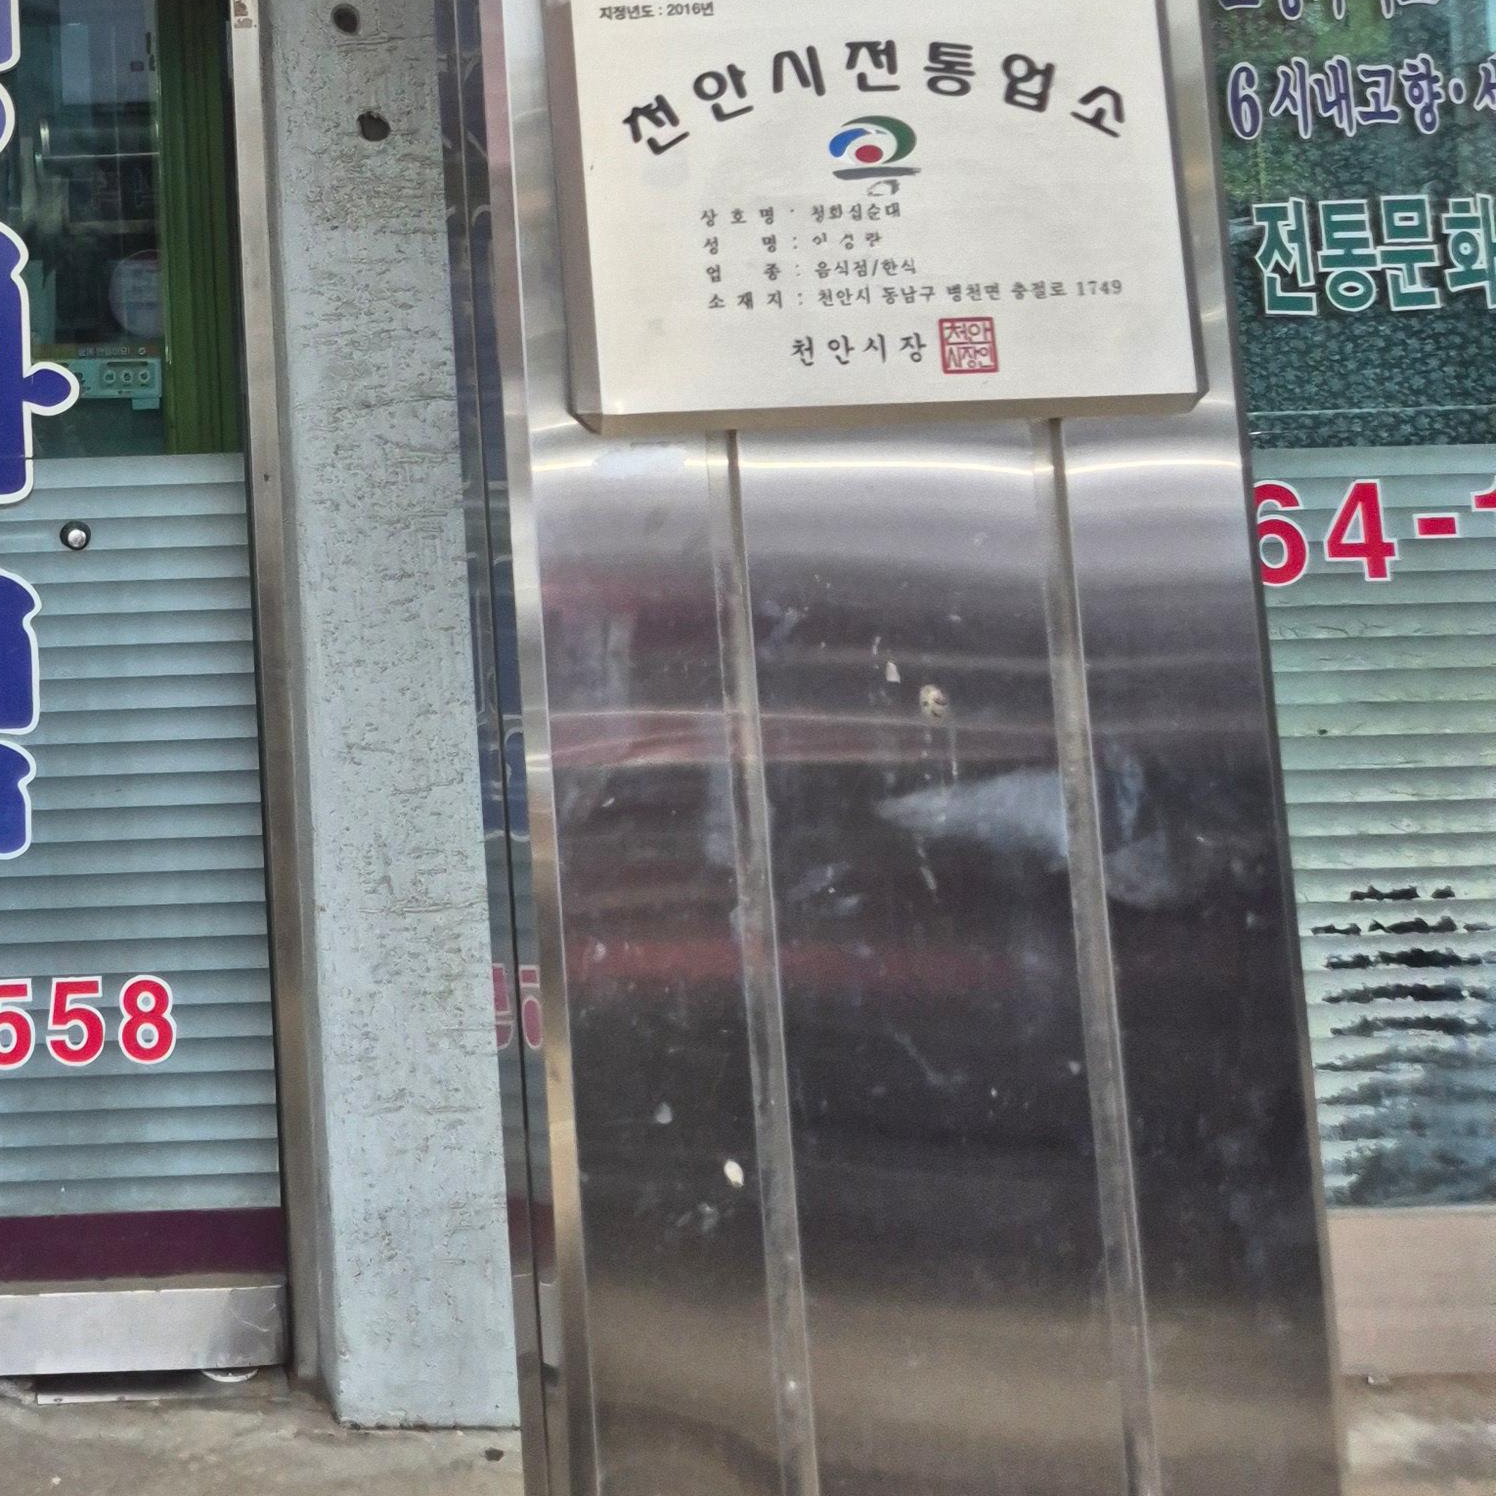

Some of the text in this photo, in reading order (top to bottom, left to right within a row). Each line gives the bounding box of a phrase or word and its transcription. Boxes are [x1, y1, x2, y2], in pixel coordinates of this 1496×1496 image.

[667, 1, 714, 16] 2016년
[814, 257, 917, 279] 음식점/한식
[818, 284, 871, 307] 천안시
[882, 285, 936, 305] 동남구
[947, 282, 1001, 303] 병천면
[1076, 279, 1123, 296] 1749
